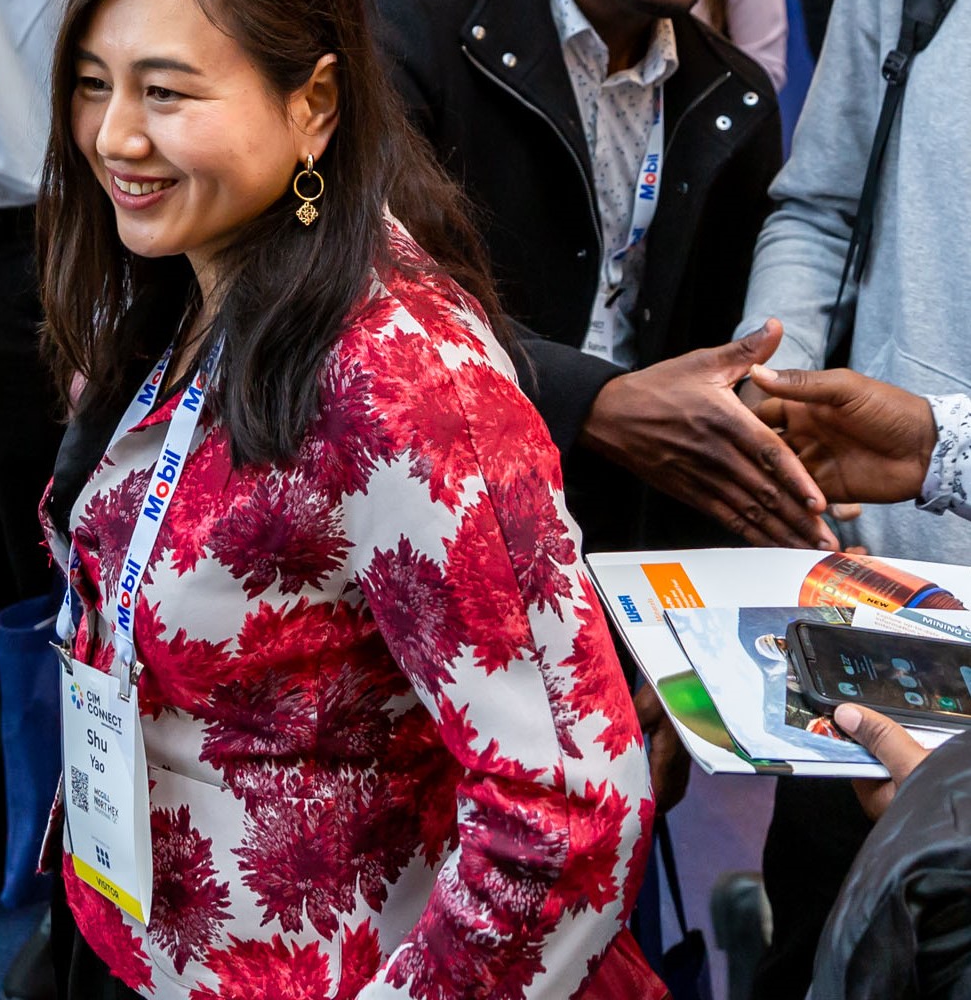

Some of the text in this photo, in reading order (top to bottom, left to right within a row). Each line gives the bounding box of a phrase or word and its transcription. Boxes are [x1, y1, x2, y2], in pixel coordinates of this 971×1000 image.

[640, 154, 659, 199] Mobil
[143, 447, 182, 522] Mobil
[117, 558, 142, 632] Mobil
[866, 597, 889, 608] NEW
[922, 616, 963, 636] MINING
[86, 690, 100, 706] CIM
[87, 703, 122, 728] CONNECT
[87, 728, 108, 754] Shu
[90, 753, 105, 773] Yao
